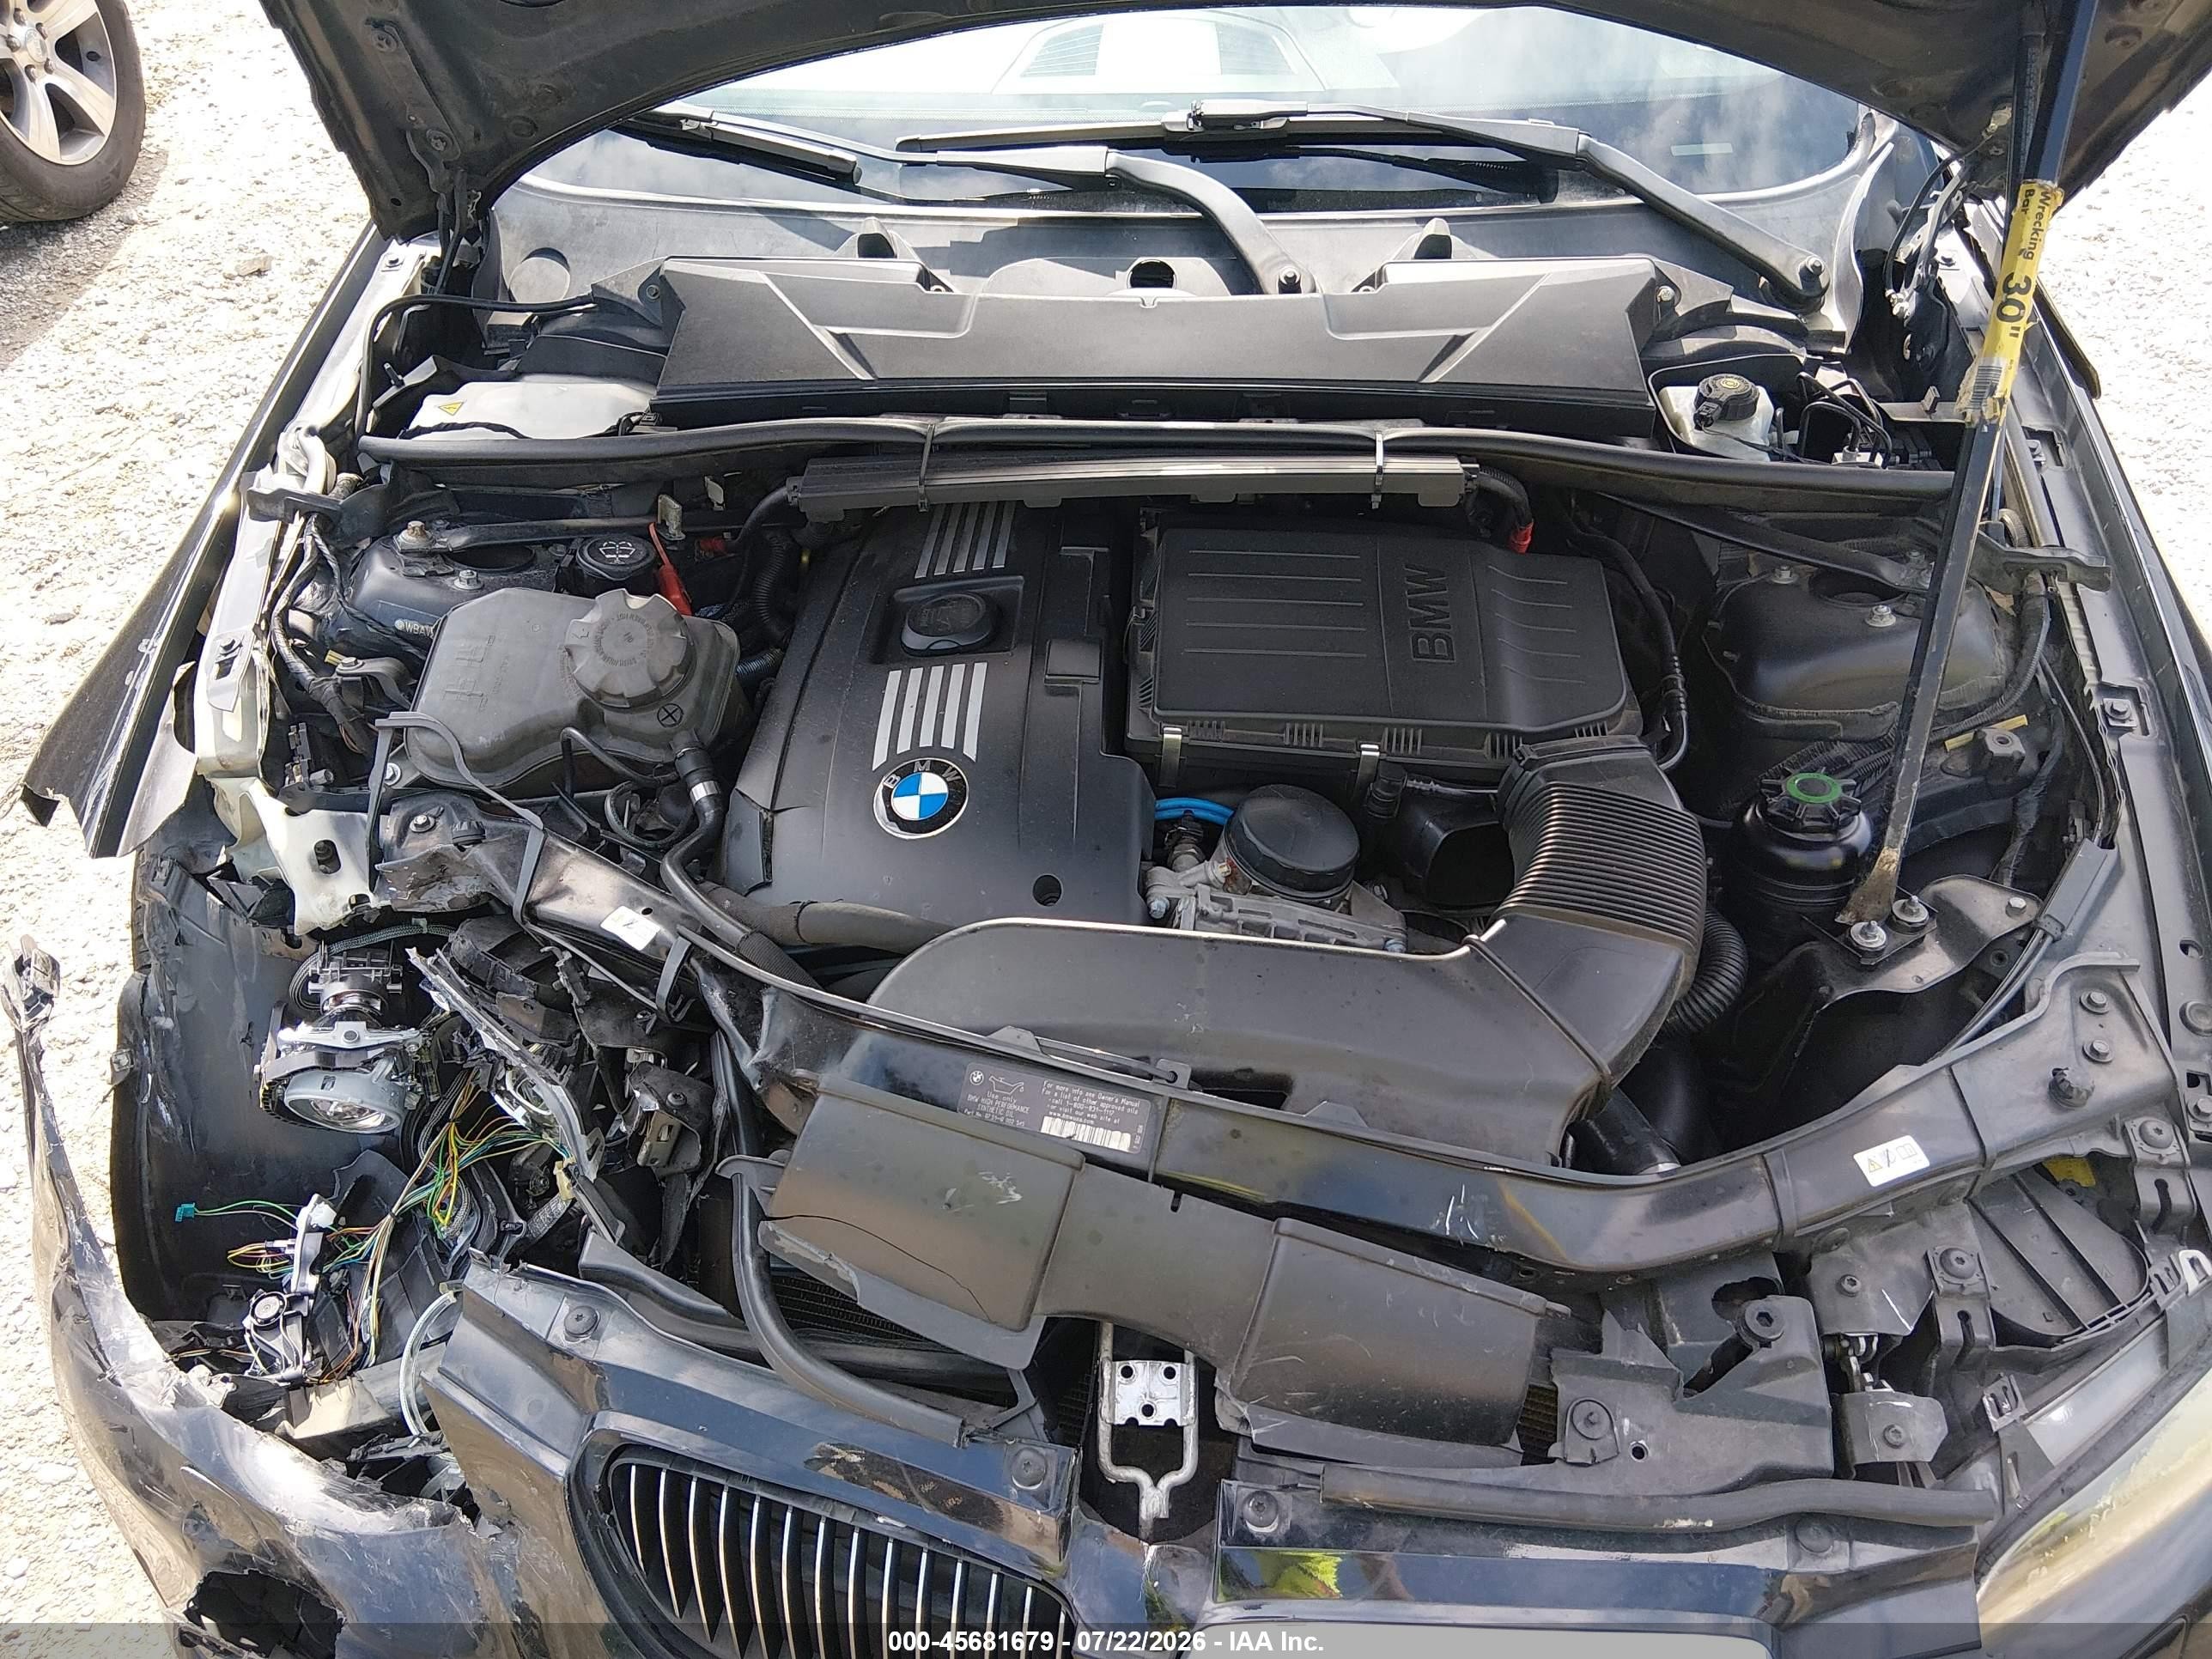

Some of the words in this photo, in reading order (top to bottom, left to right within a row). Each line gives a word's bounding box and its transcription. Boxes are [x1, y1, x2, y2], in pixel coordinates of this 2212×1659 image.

[2021, 189, 2035, 215] Bar
[2019, 191, 2051, 260] Wrecking
[1996, 272, 2032, 338] 30"
[1403, 564, 1455, 662] BMW
[883, 760, 962, 789] BMW
[1002, 1094, 1017, 1103] only
[1121, 1098, 1140, 1108] Manual
